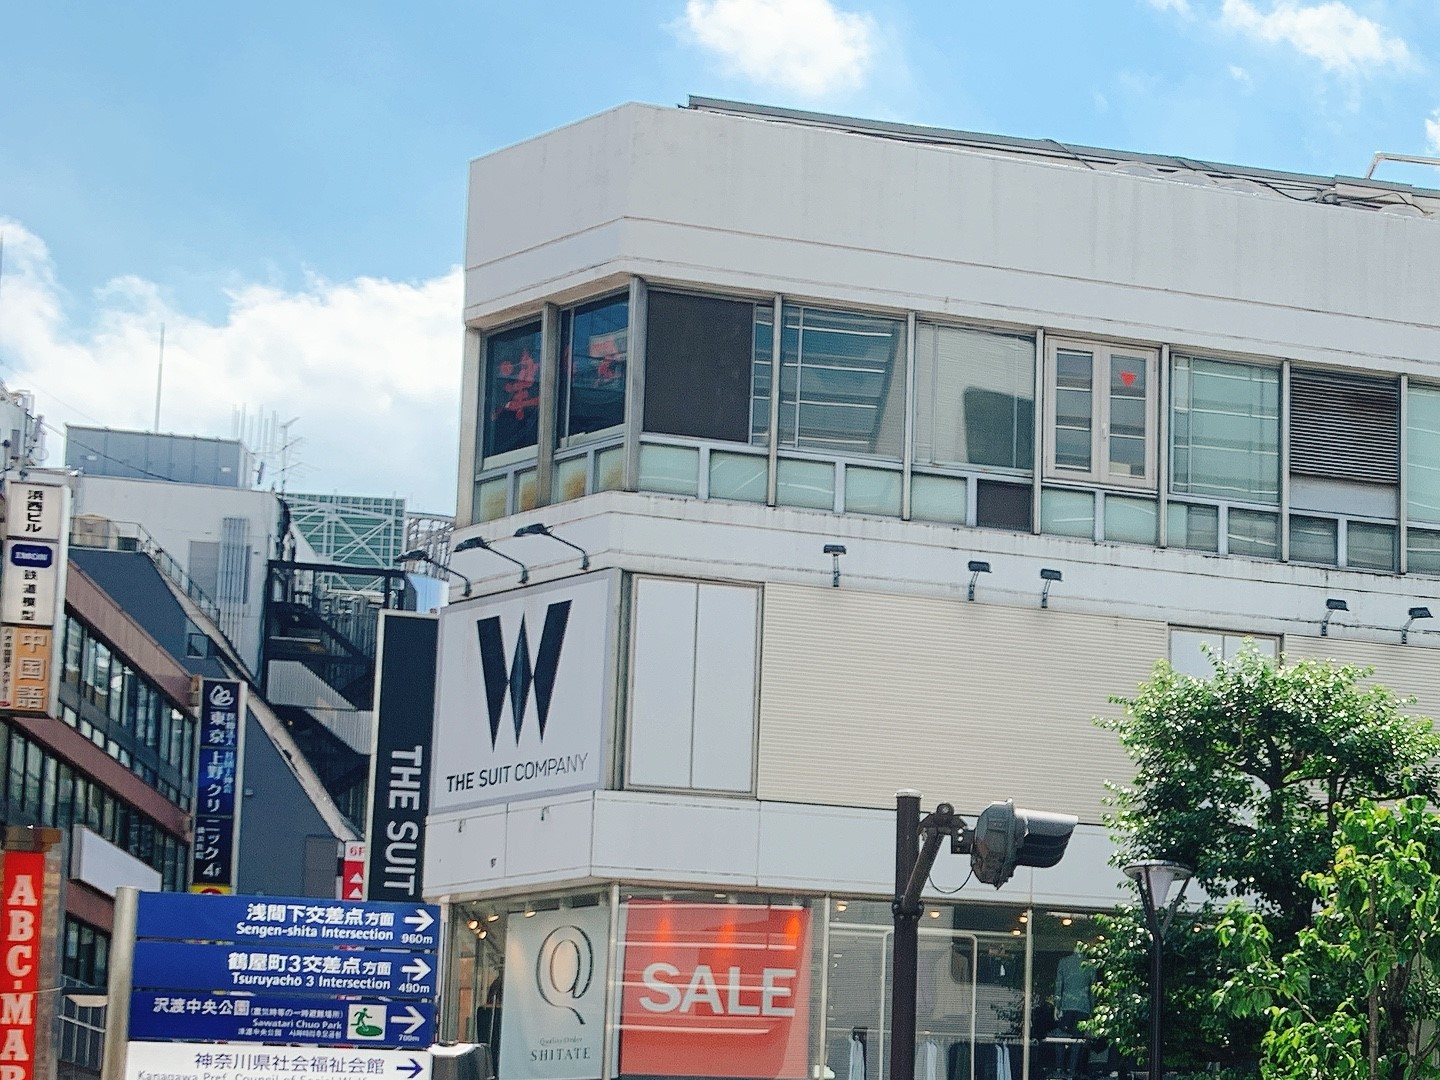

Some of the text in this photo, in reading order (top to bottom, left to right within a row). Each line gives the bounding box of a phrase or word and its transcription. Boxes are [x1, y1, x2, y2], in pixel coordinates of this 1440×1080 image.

[16, 631, 48, 708] 中国語
[446, 752, 589, 793] THE SUIT COMPANY
[383, 745, 423, 897] THE SUIT
[246, 902, 395, 927] 浅間下交差点方面
[236, 922, 394, 941] Sengen-shita Intersection
[227, 951, 392, 976] 鶴屋町3交差点方面
[305, 975, 315, 988] 3
[318, 975, 391, 990] Intersection
[399, 983, 430, 993] 490m
[639, 961, 798, 1018] SALE
[152, 997, 250, 1017] 沢渡中央公園
[252, 1018, 342, 1030] Sawatari Chuo Park
[194, 1052, 385, 1075] 神奈川県社会福祉会館
[529, 1046, 591, 1062] SHITATE
